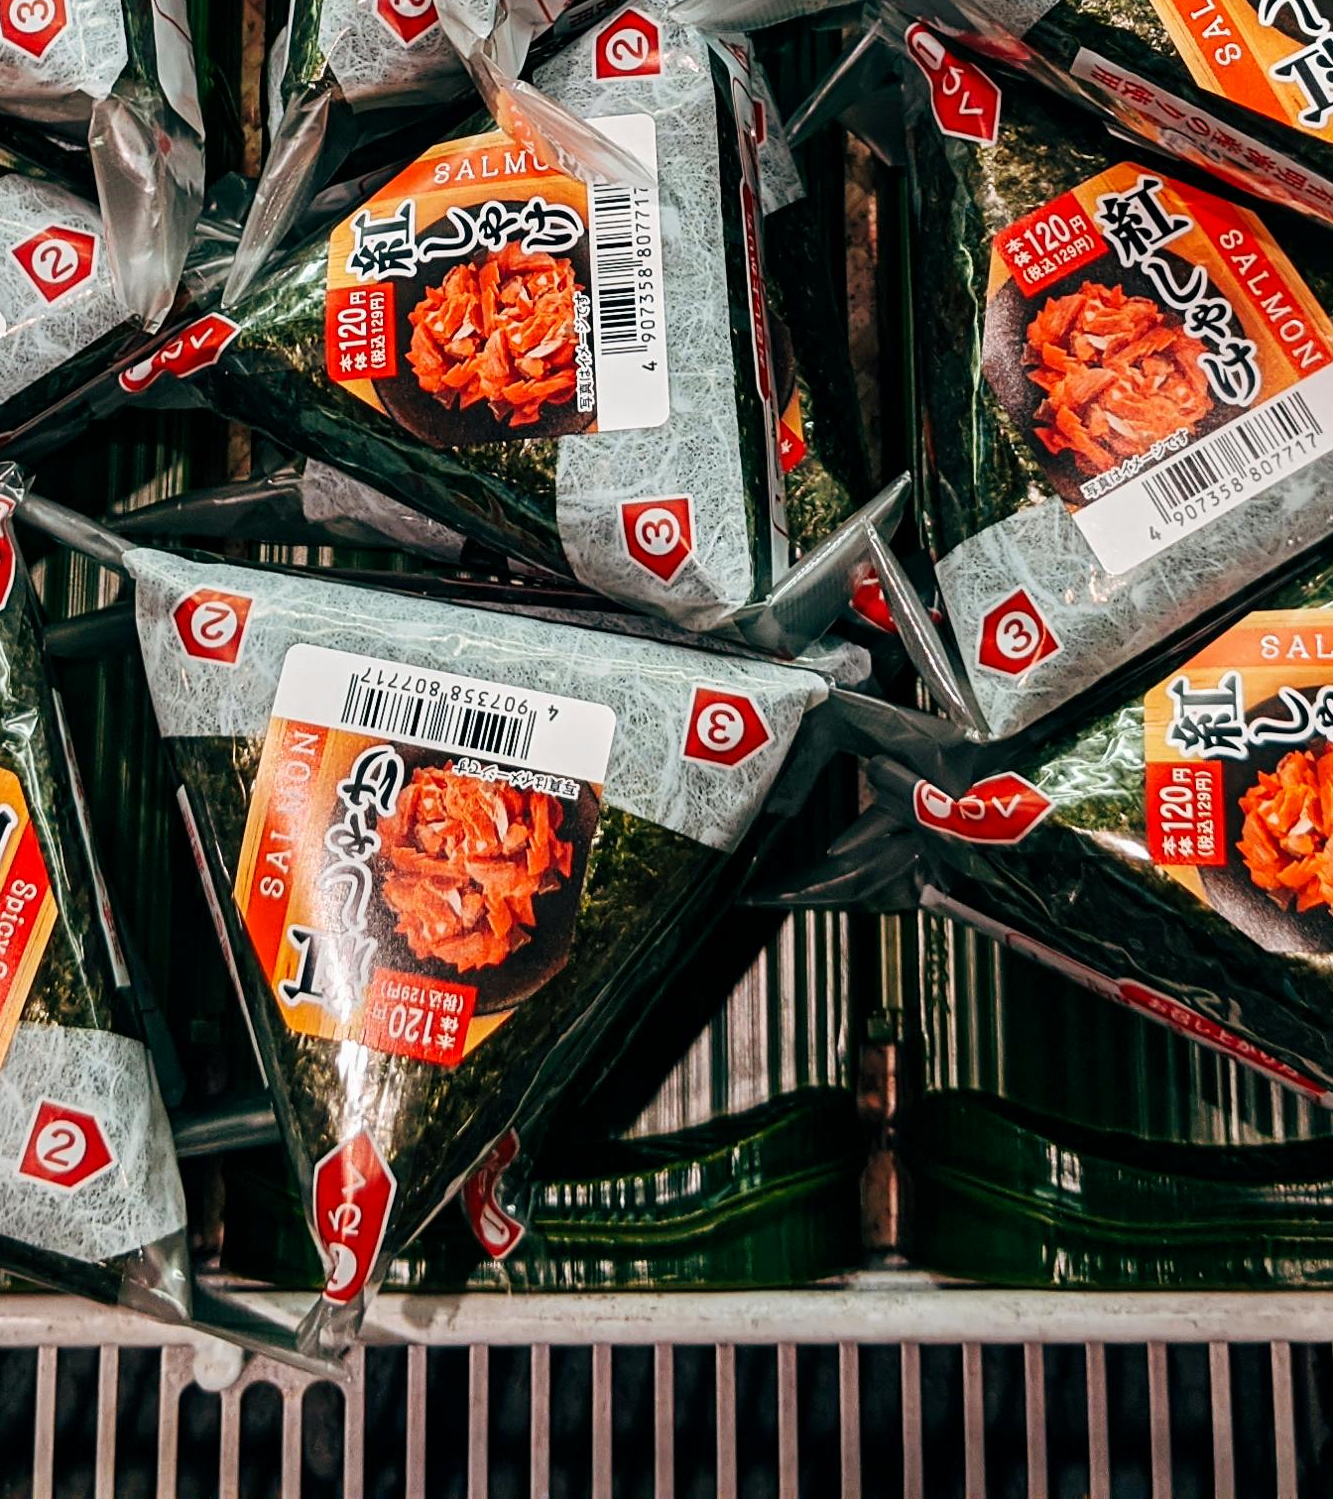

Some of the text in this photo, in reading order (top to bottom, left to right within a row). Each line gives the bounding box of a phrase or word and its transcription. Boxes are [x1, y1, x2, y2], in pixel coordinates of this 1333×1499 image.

[433, 149, 550, 185] SALM
[350, 199, 580, 273] 紅しゃけ
[1019, 233, 1098, 286] (税込129円)
[1096, 176, 1267, 401] 紅しゃけ
[1215, 227, 1324, 371] SALMON
[370, 290, 386, 370] (税込129円)
[260, 730, 320, 900] SALMON
[1196, 770, 1215, 858] (税込129円)
[378, 978, 467, 1014] (税込129円)
